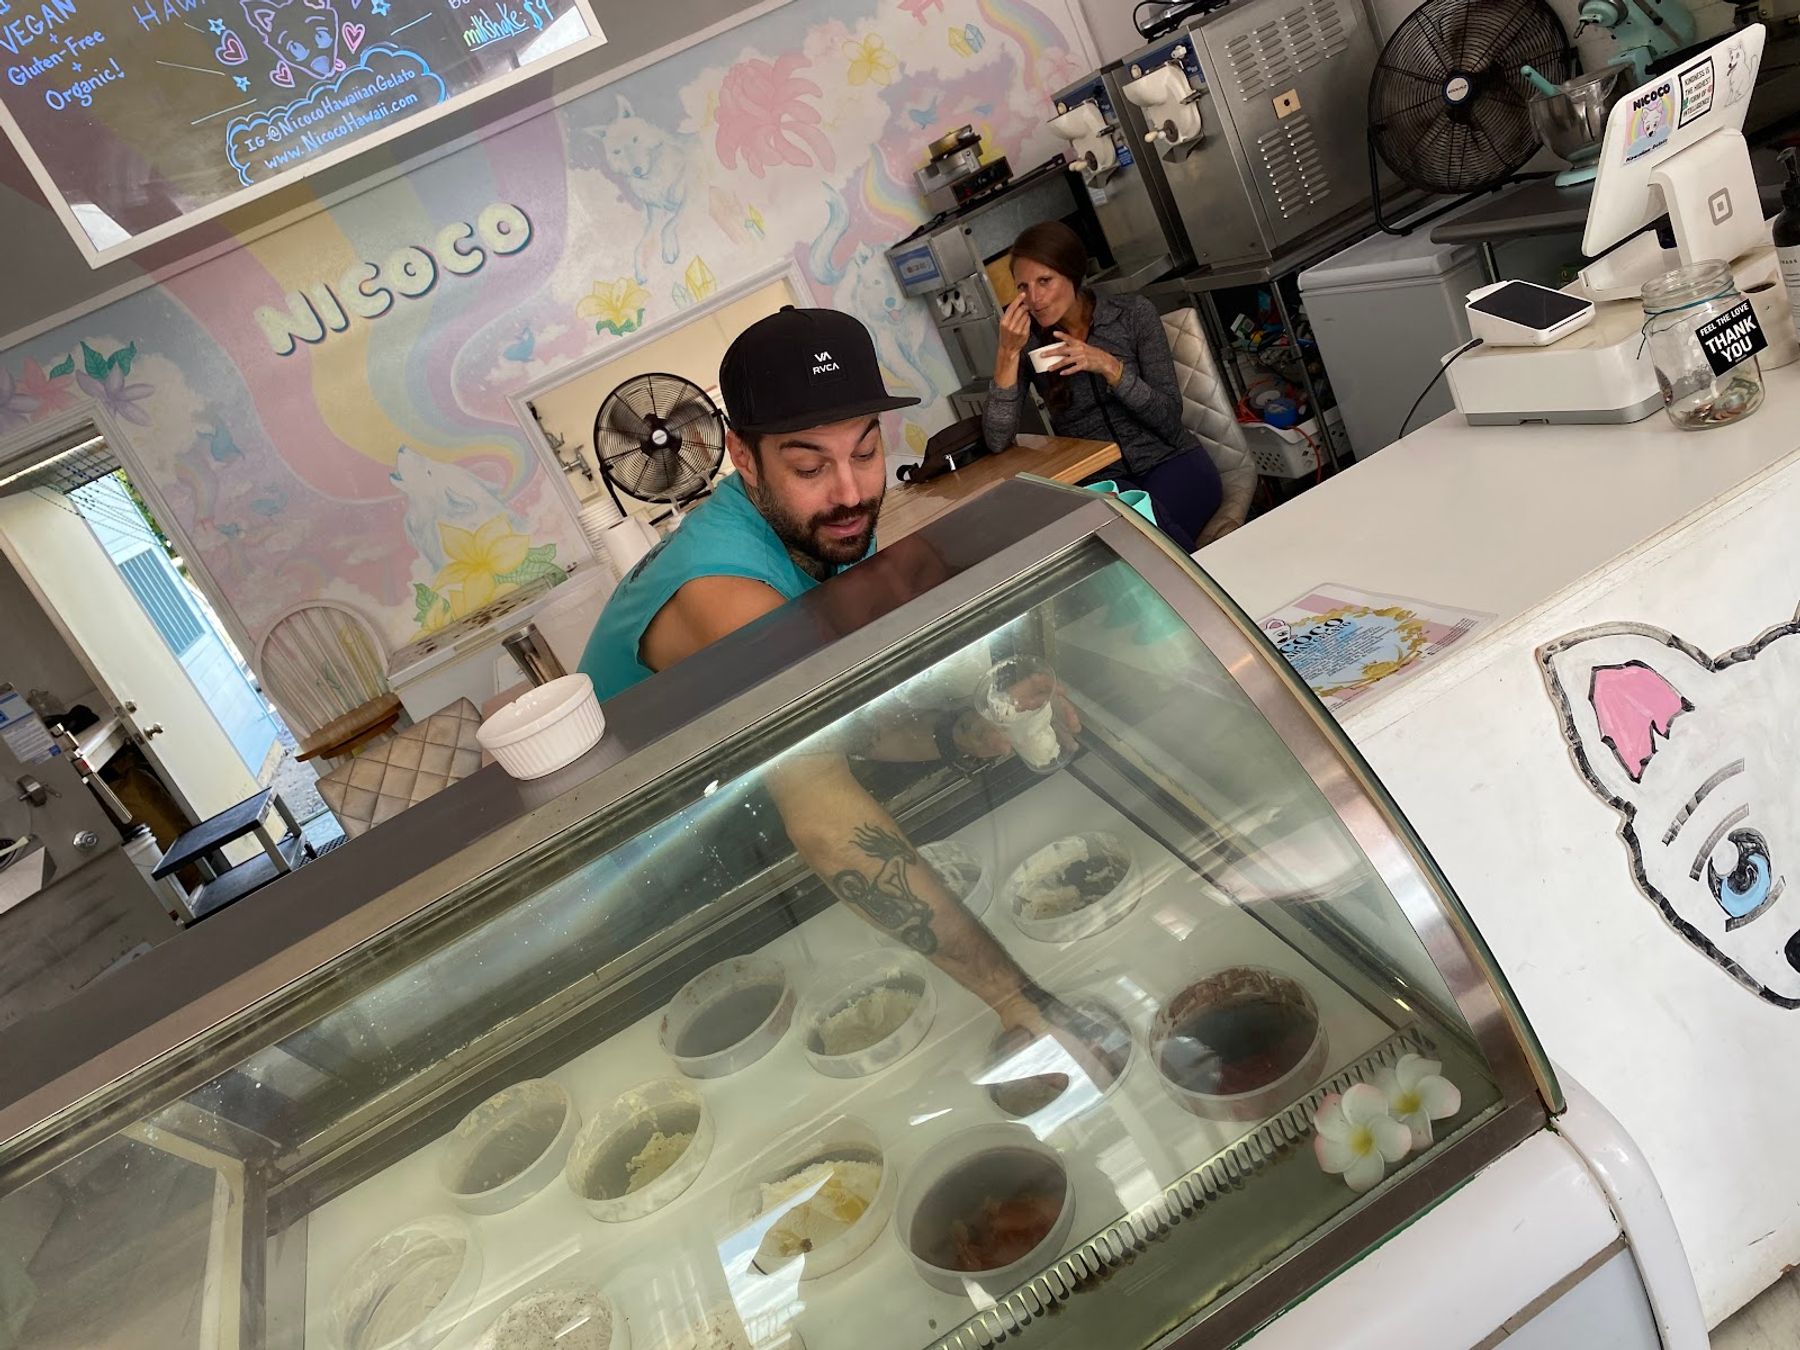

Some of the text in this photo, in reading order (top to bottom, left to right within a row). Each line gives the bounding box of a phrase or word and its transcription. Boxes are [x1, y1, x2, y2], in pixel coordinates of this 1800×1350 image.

[0, 0, 77, 54] VEGAN
[7, 30, 105, 86] Gluten-Free
[45, 57, 125, 110] Organic!
[1633, 83, 1671, 111] NICOCO
[252, 202, 534, 357] NICOCO
[1700, 302, 1750, 337] FEEL THE LOVE
[1705, 315, 1757, 354] THANK
[812, 362, 840, 375] RVCA
[1721, 336, 1753, 362] YOU
